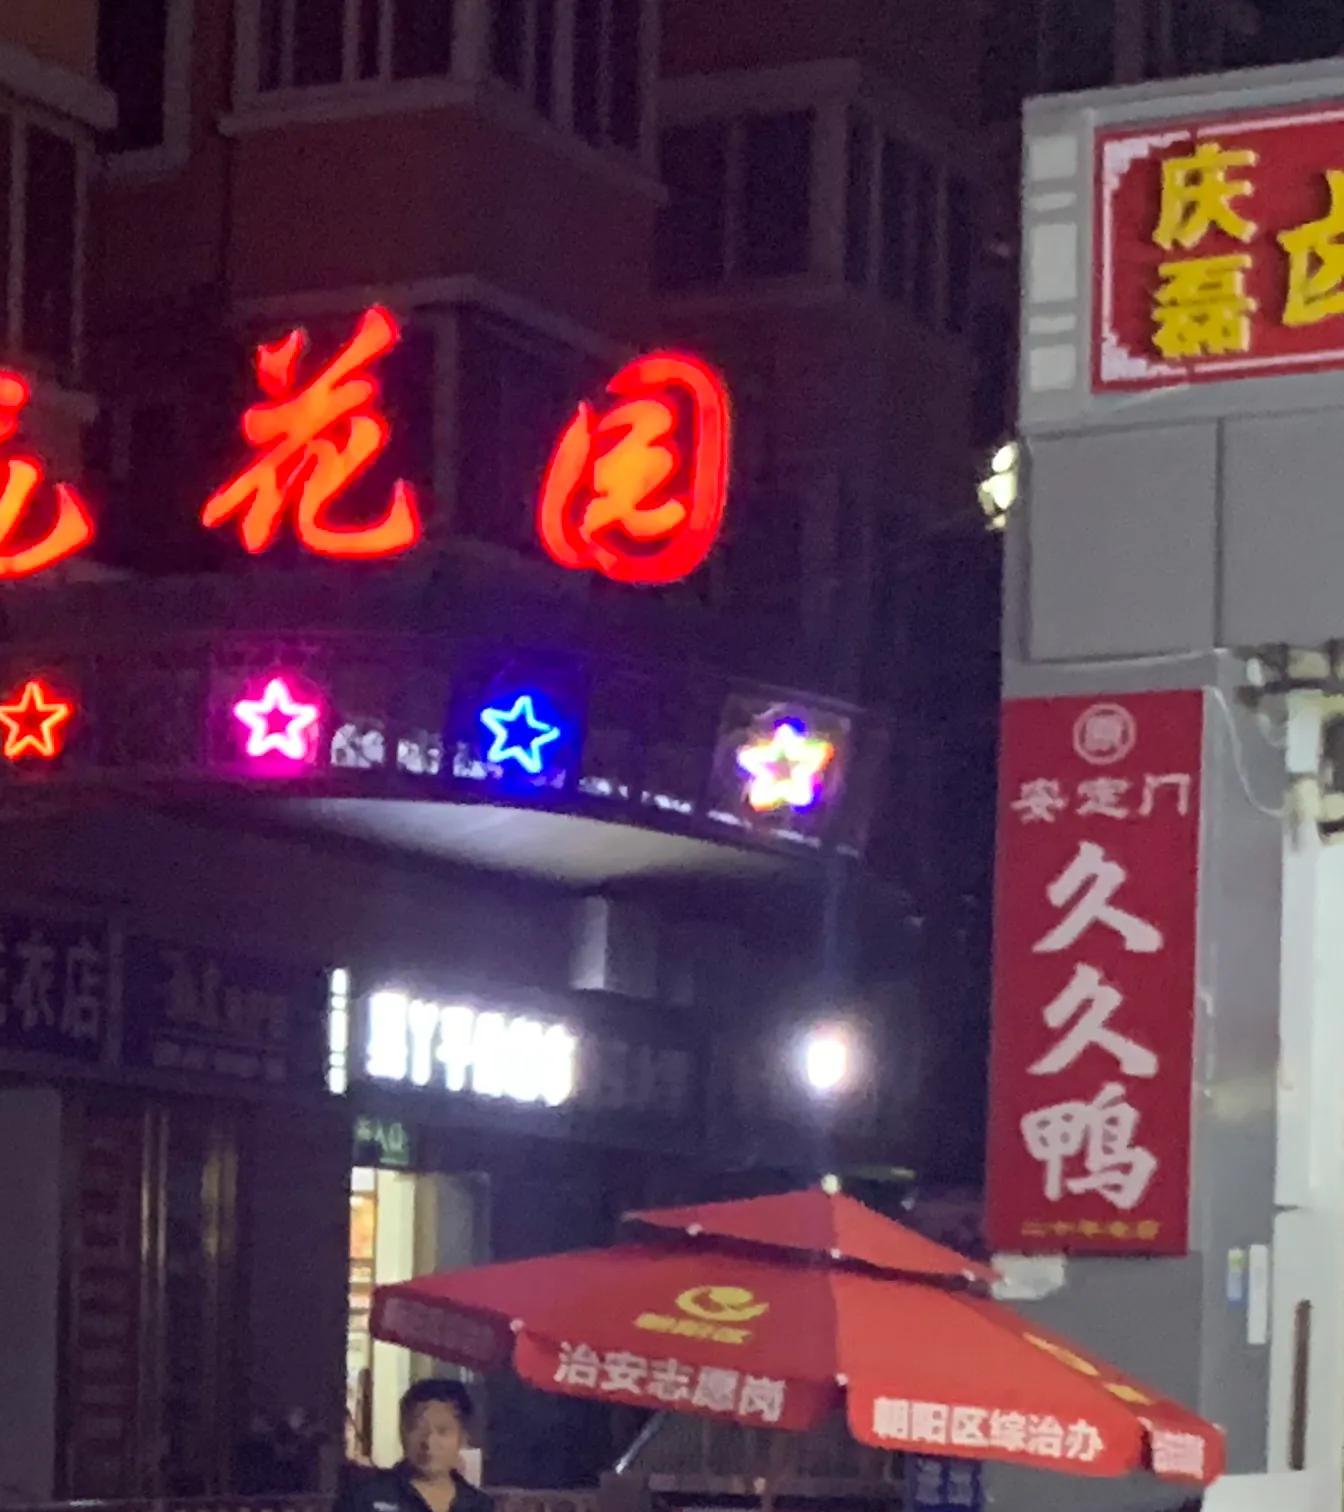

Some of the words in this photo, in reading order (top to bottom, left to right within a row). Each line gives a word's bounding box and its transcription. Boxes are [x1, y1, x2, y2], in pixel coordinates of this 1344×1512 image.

[1011, 772, 1193, 823] 安定门
[1020, 839, 1166, 1210] 久久鸭
[552, 1340, 787, 1423] 治安志愿岗
[872, 1395, 1105, 1463] 朝阳区综治办
